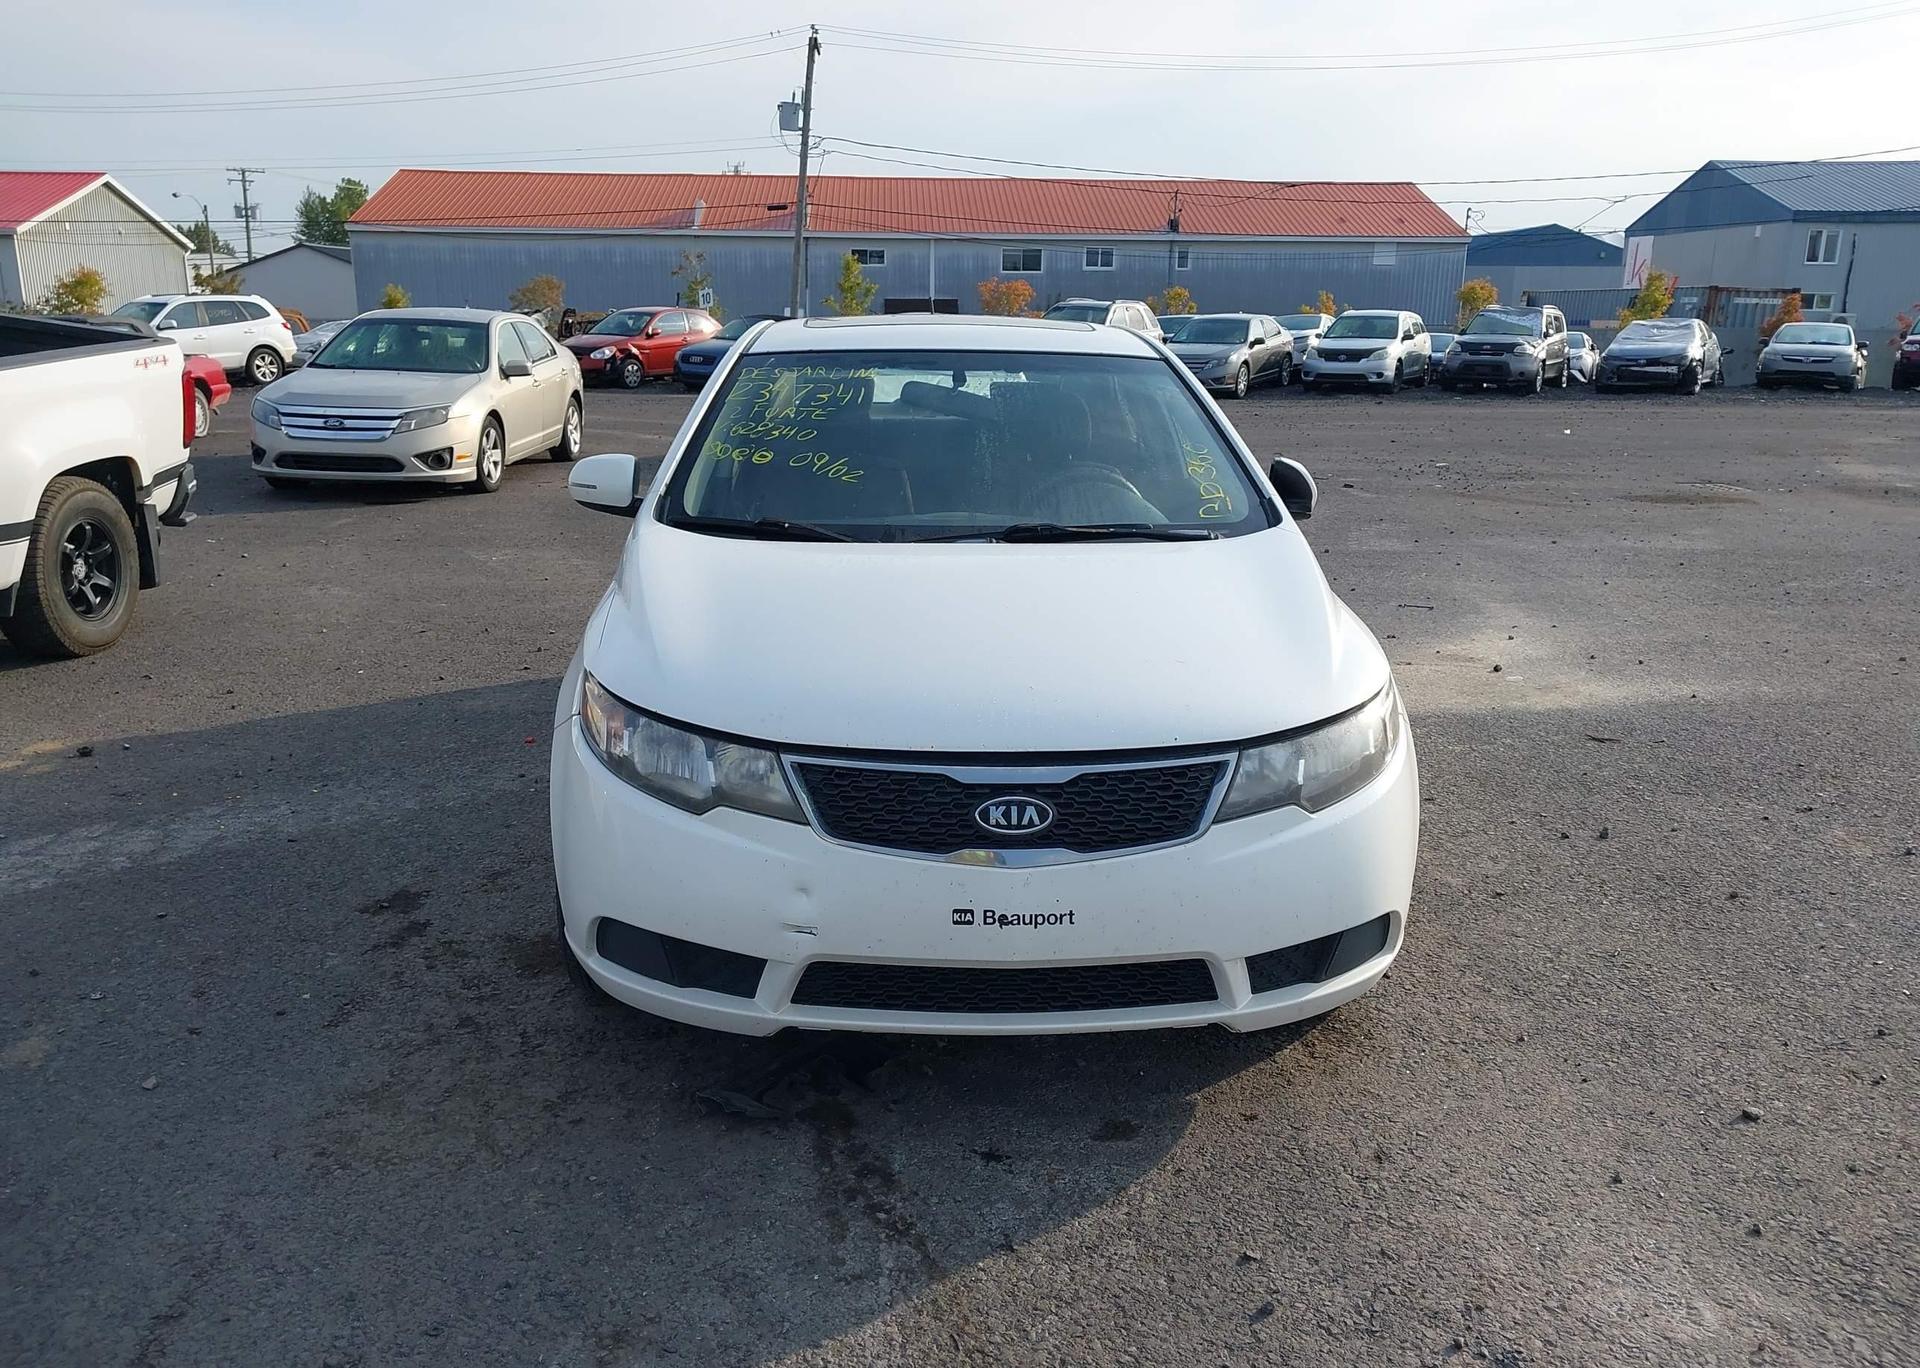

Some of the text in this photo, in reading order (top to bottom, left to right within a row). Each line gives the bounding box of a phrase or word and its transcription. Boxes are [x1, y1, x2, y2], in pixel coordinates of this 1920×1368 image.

[701, 292, 711, 305] 10
[988, 805, 1041, 826] KIA
[953, 909, 1076, 930] KIA Beauport
